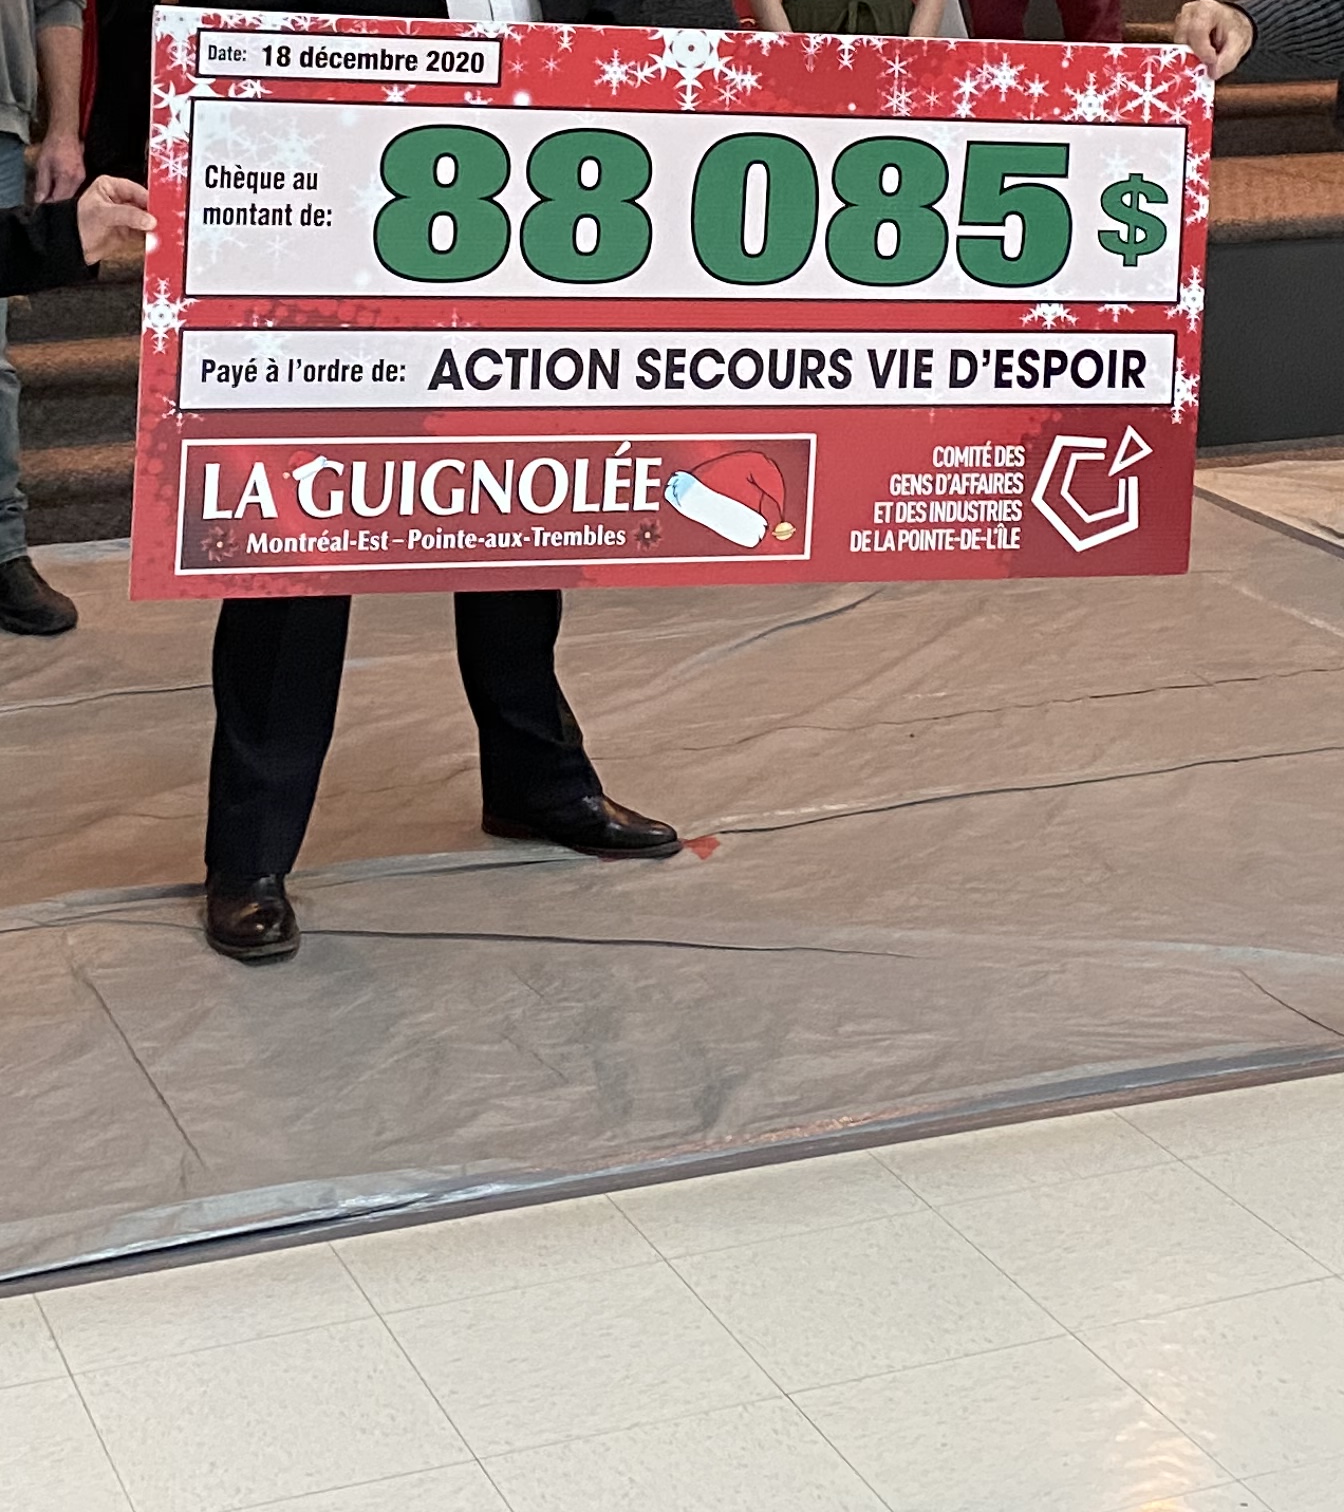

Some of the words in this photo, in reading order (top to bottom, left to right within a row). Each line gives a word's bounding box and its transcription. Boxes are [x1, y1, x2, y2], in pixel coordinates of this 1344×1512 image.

[207, 44, 247, 62] Date:
[262, 44, 291, 68] 18
[299, 44, 418, 73] décembre
[425, 50, 485, 75] 2020
[205, 164, 285, 194] Chèque
[292, 172, 318, 190] au
[203, 202, 292, 226] montant
[300, 203, 332, 227] de:
[373, 124, 653, 283] 88
[691, 132, 1072, 287] 085
[1097, 173, 1169, 267] $
[201, 358, 257, 388] Payé
[266, 358, 279, 383] à
[371, 359, 406, 383] de:
[427, 347, 621, 391] ACTION
[635, 348, 854, 390] SECOURS
[867, 348, 933, 390] VIE
[931, 440, 992, 468] COMITÉ
[994, 445, 1026, 468] DES
[202, 462, 279, 520] LA
[296, 440, 663, 519] GUIGNOLÉE
[889, 473, 933, 496] GENS
[873, 501, 894, 524] ET
[895, 501, 927, 524] DES
[929, 499, 1024, 523] INDUSTRIES
[246, 528, 389, 554] Montréal-Est
[408, 524, 627, 551] Pointe-aux-Trembles
[849, 529, 872, 552] DE
[873, 529, 896, 552] LA
